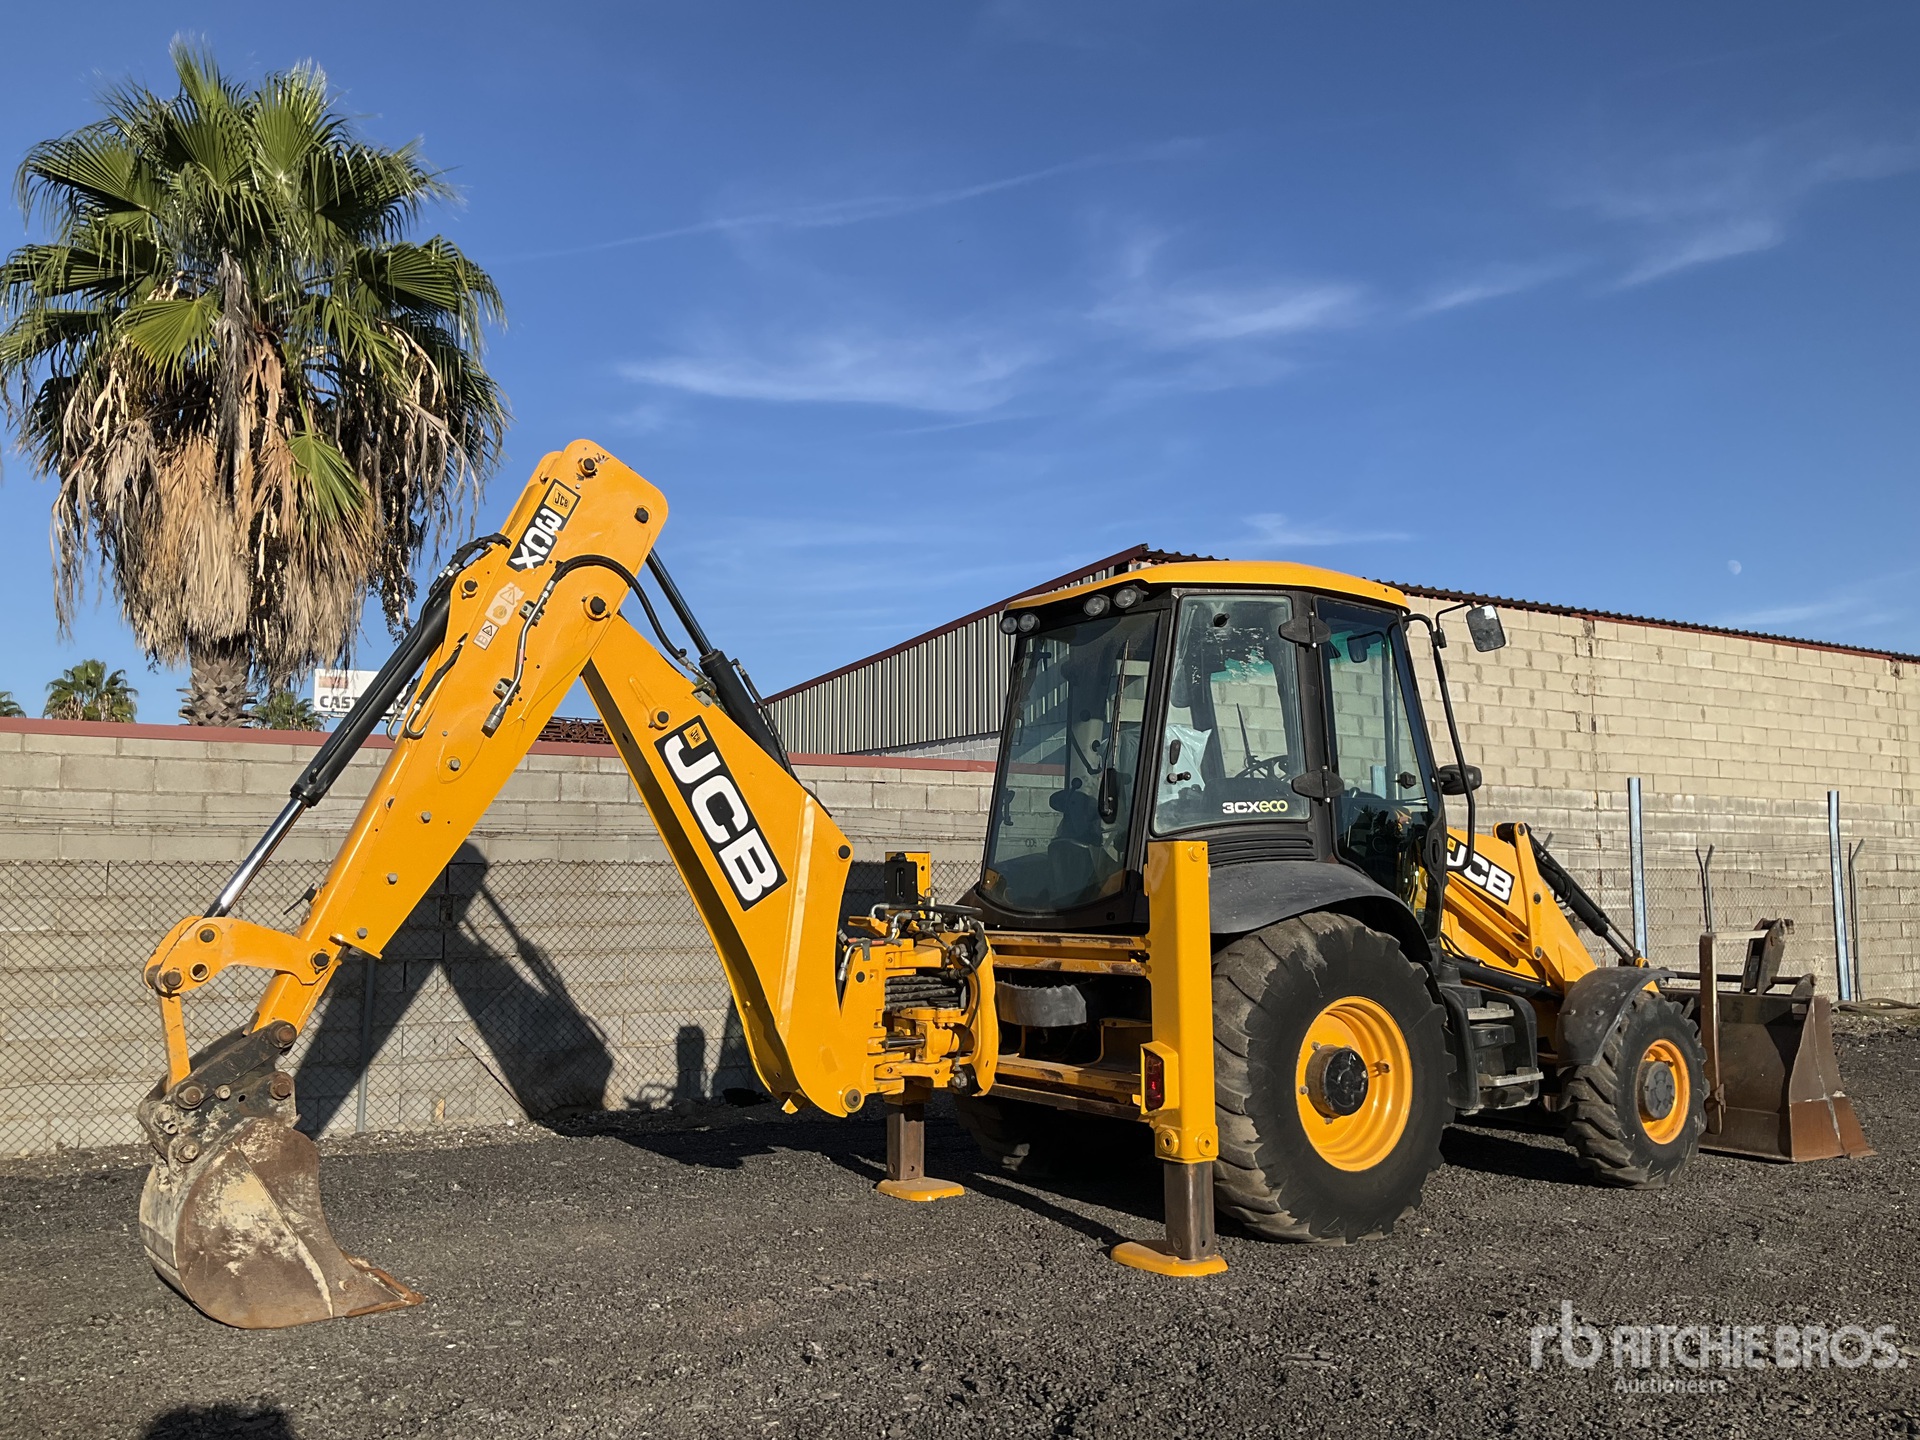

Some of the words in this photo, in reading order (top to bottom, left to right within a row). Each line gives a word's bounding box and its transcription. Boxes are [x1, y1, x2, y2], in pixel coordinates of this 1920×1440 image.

[554, 492, 569, 508] JCB
[664, 735, 778, 901] JCB
[1222, 800, 1288, 814] 3CXeco
[1446, 844, 1513, 901] JCB
